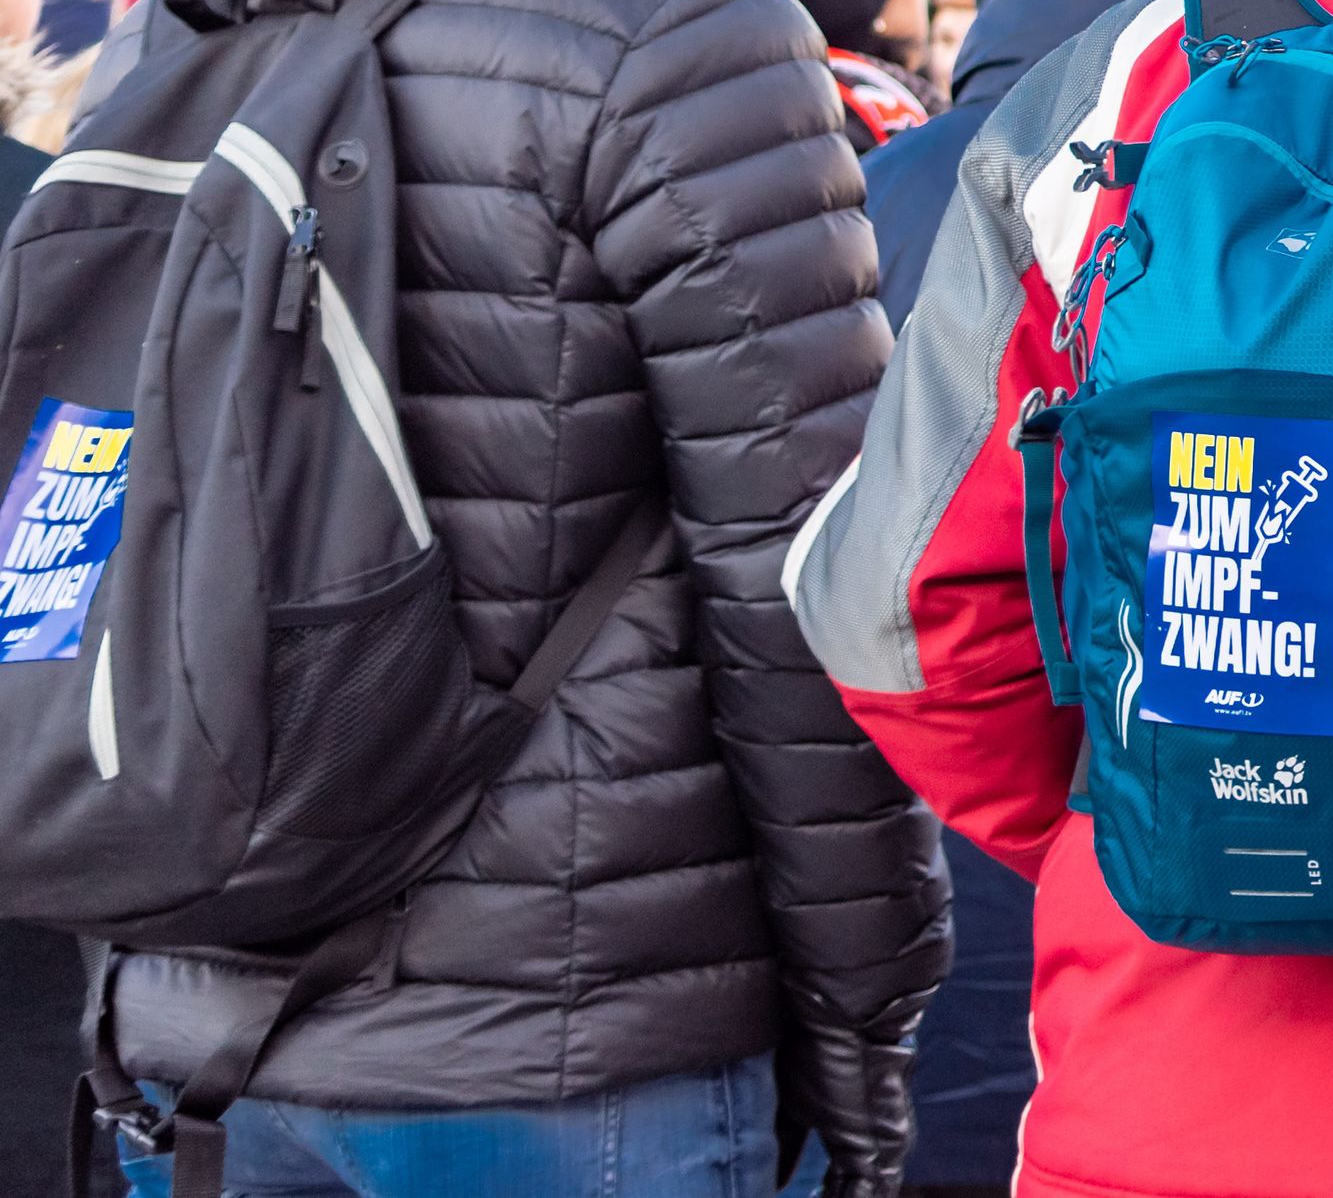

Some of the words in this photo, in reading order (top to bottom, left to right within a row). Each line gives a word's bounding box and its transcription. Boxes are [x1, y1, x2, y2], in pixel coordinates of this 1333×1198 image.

[43, 420, 135, 473] NEIN
[1169, 431, 1254, 493] NEIN
[22, 470, 107, 522] ZUM
[1167, 491, 1251, 554] ZUM
[2, 519, 88, 571] IMPF-
[0, 562, 94, 619] ZWANG!
[1162, 550, 1279, 614] IMPF-
[1160, 610, 1317, 678] ZWANG!
[1208, 757, 1262, 782] Jack
[1210, 776, 1309, 805] Wolfskin
[1306, 859, 1322, 886] LED
